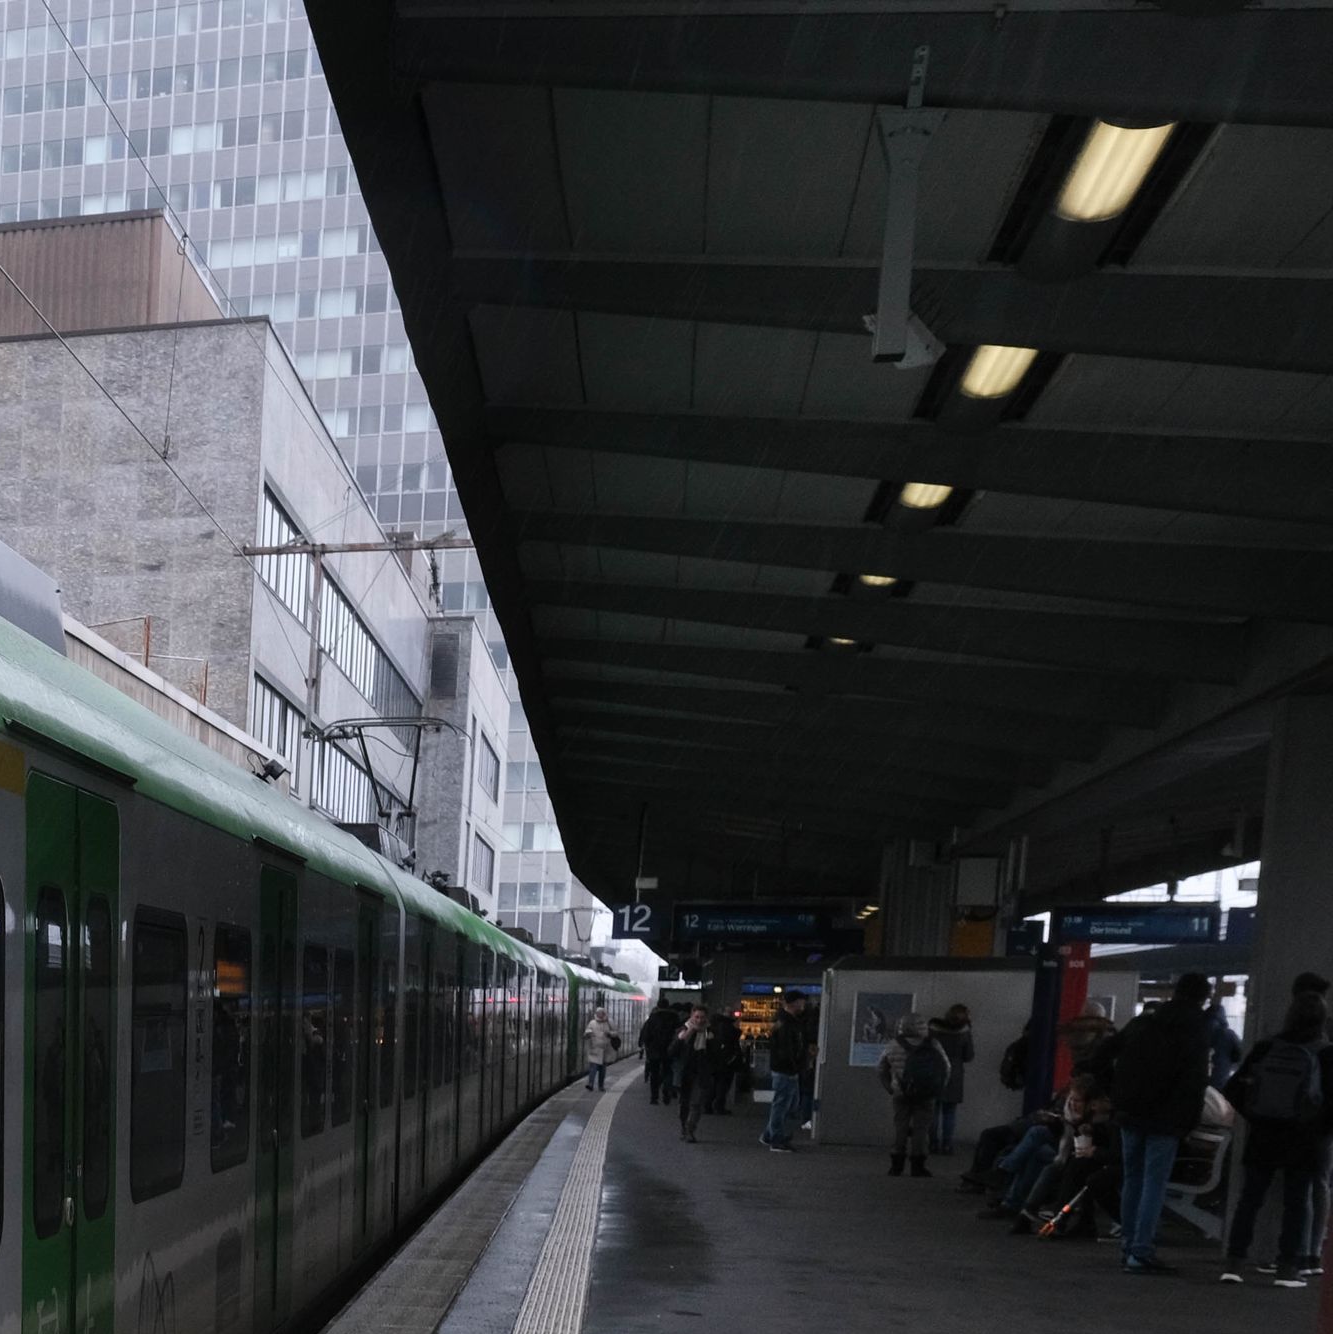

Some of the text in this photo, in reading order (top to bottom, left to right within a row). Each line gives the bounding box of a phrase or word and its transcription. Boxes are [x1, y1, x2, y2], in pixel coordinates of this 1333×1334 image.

[619, 904, 652, 932] 12
[683, 914, 699, 928] 12
[1191, 917, 1209, 931] 11
[1090, 926, 1132, 935] Dortmund
[661, 967, 679, 979] 12
